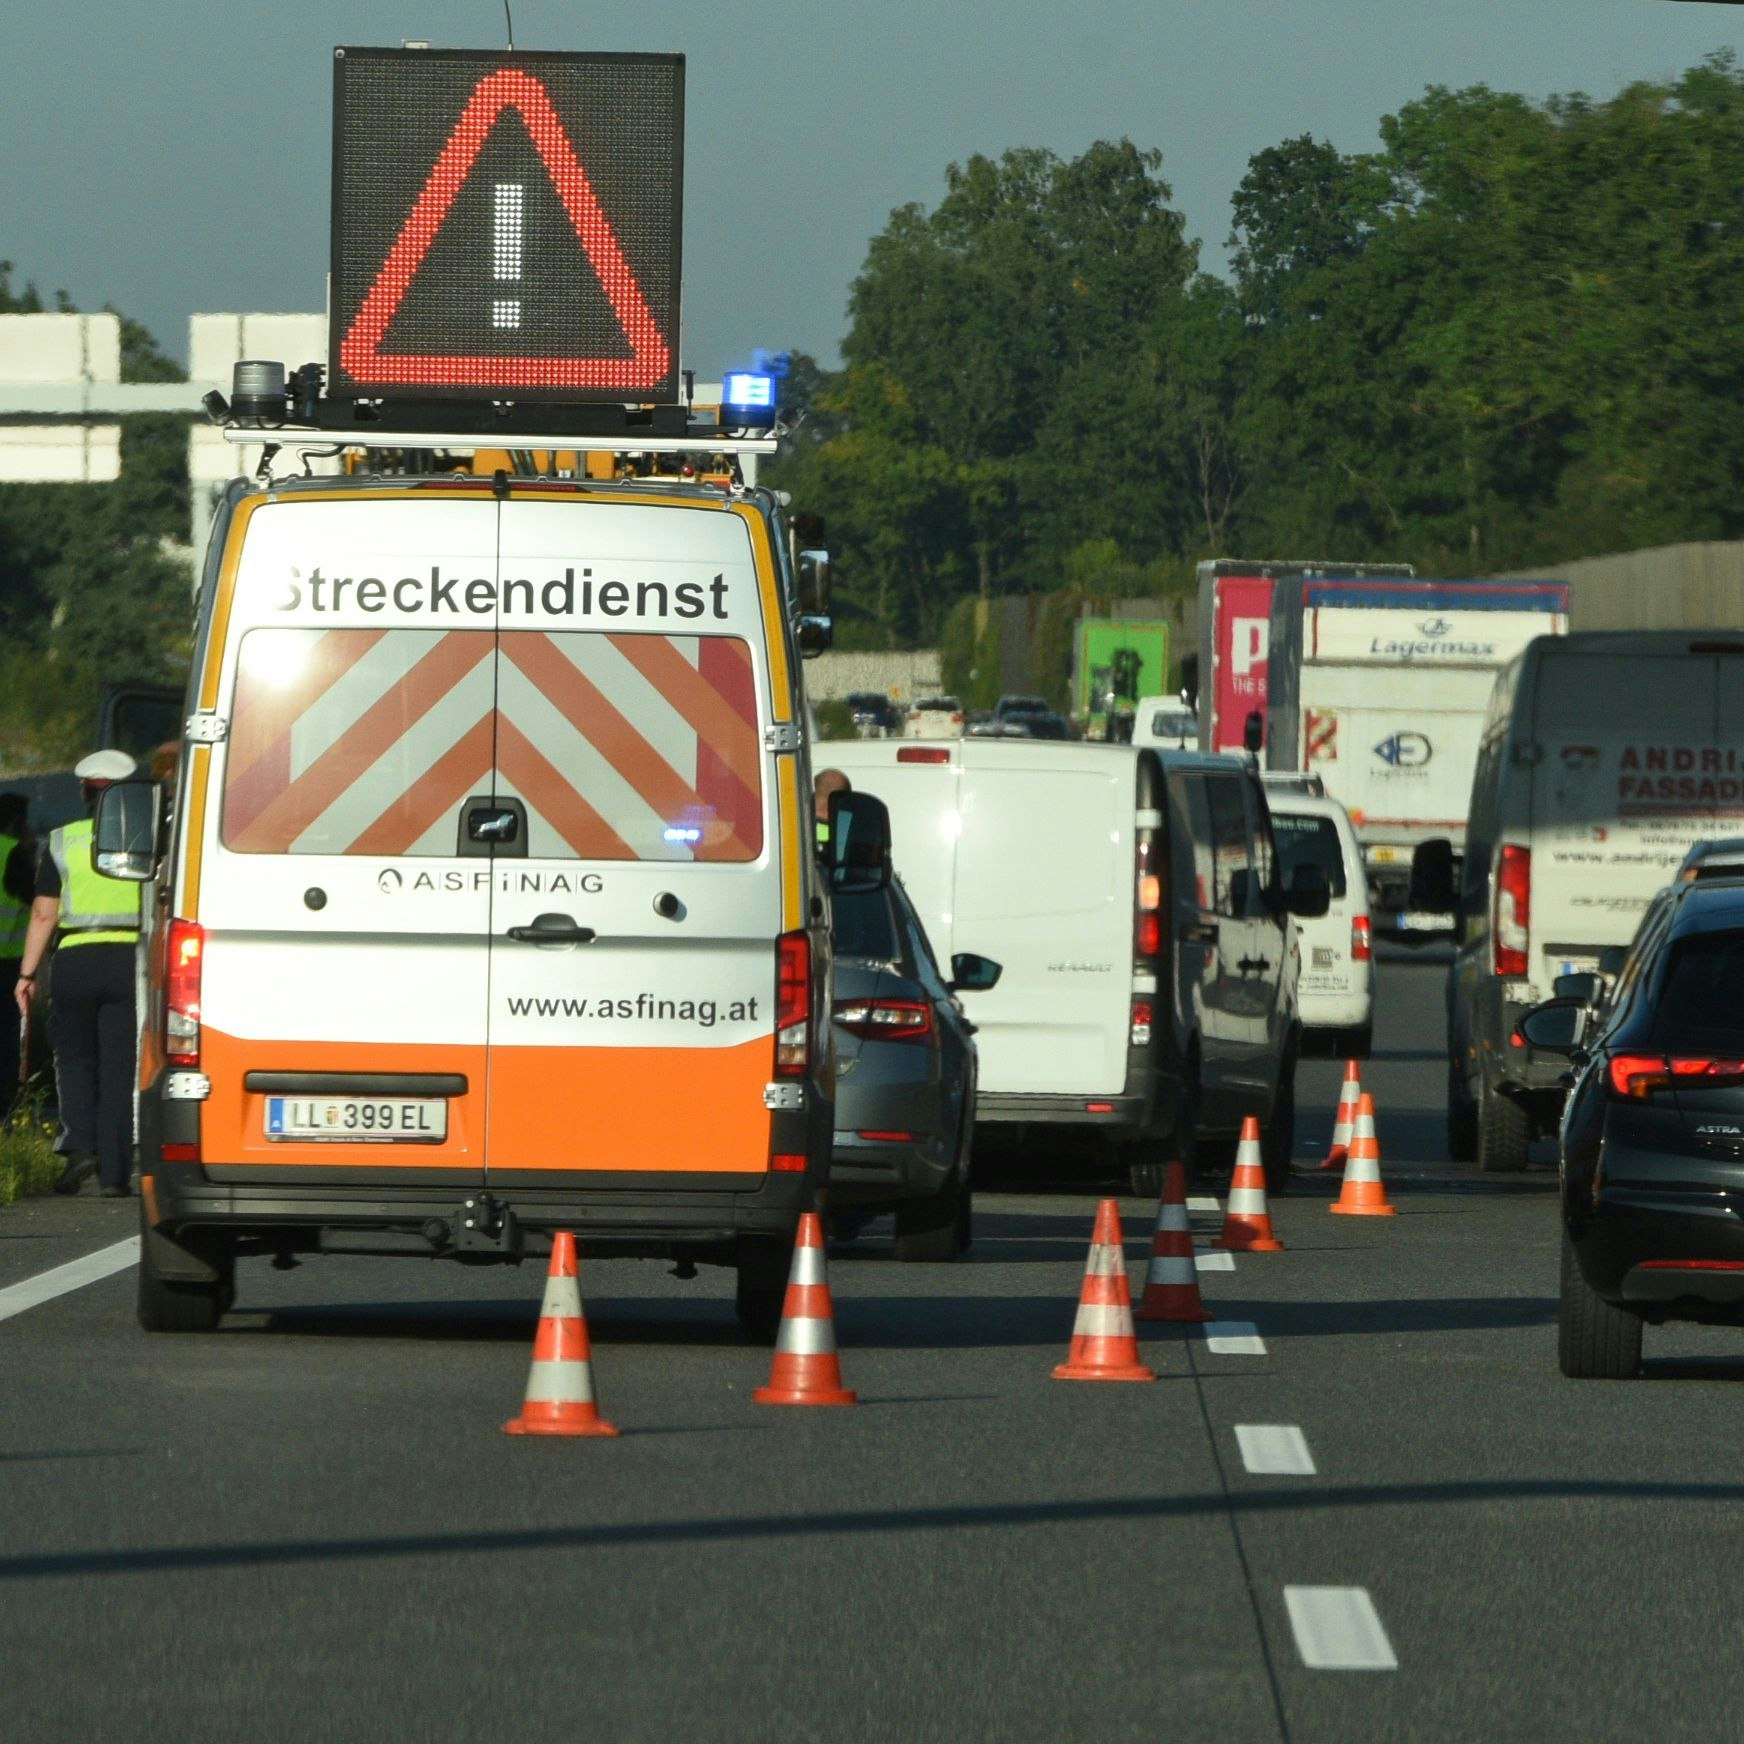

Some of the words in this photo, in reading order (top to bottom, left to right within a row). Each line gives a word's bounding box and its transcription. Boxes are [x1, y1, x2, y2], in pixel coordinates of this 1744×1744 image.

[273, 565, 729, 620] Streckendienst
[1369, 637, 1496, 659] Lagermax
[507, 992, 759, 1028] www.asfinag.at
[344, 1103, 394, 1131] 399
[401, 1105, 431, 1131] EL
[1696, 1125, 1741, 1134] ASTRA
